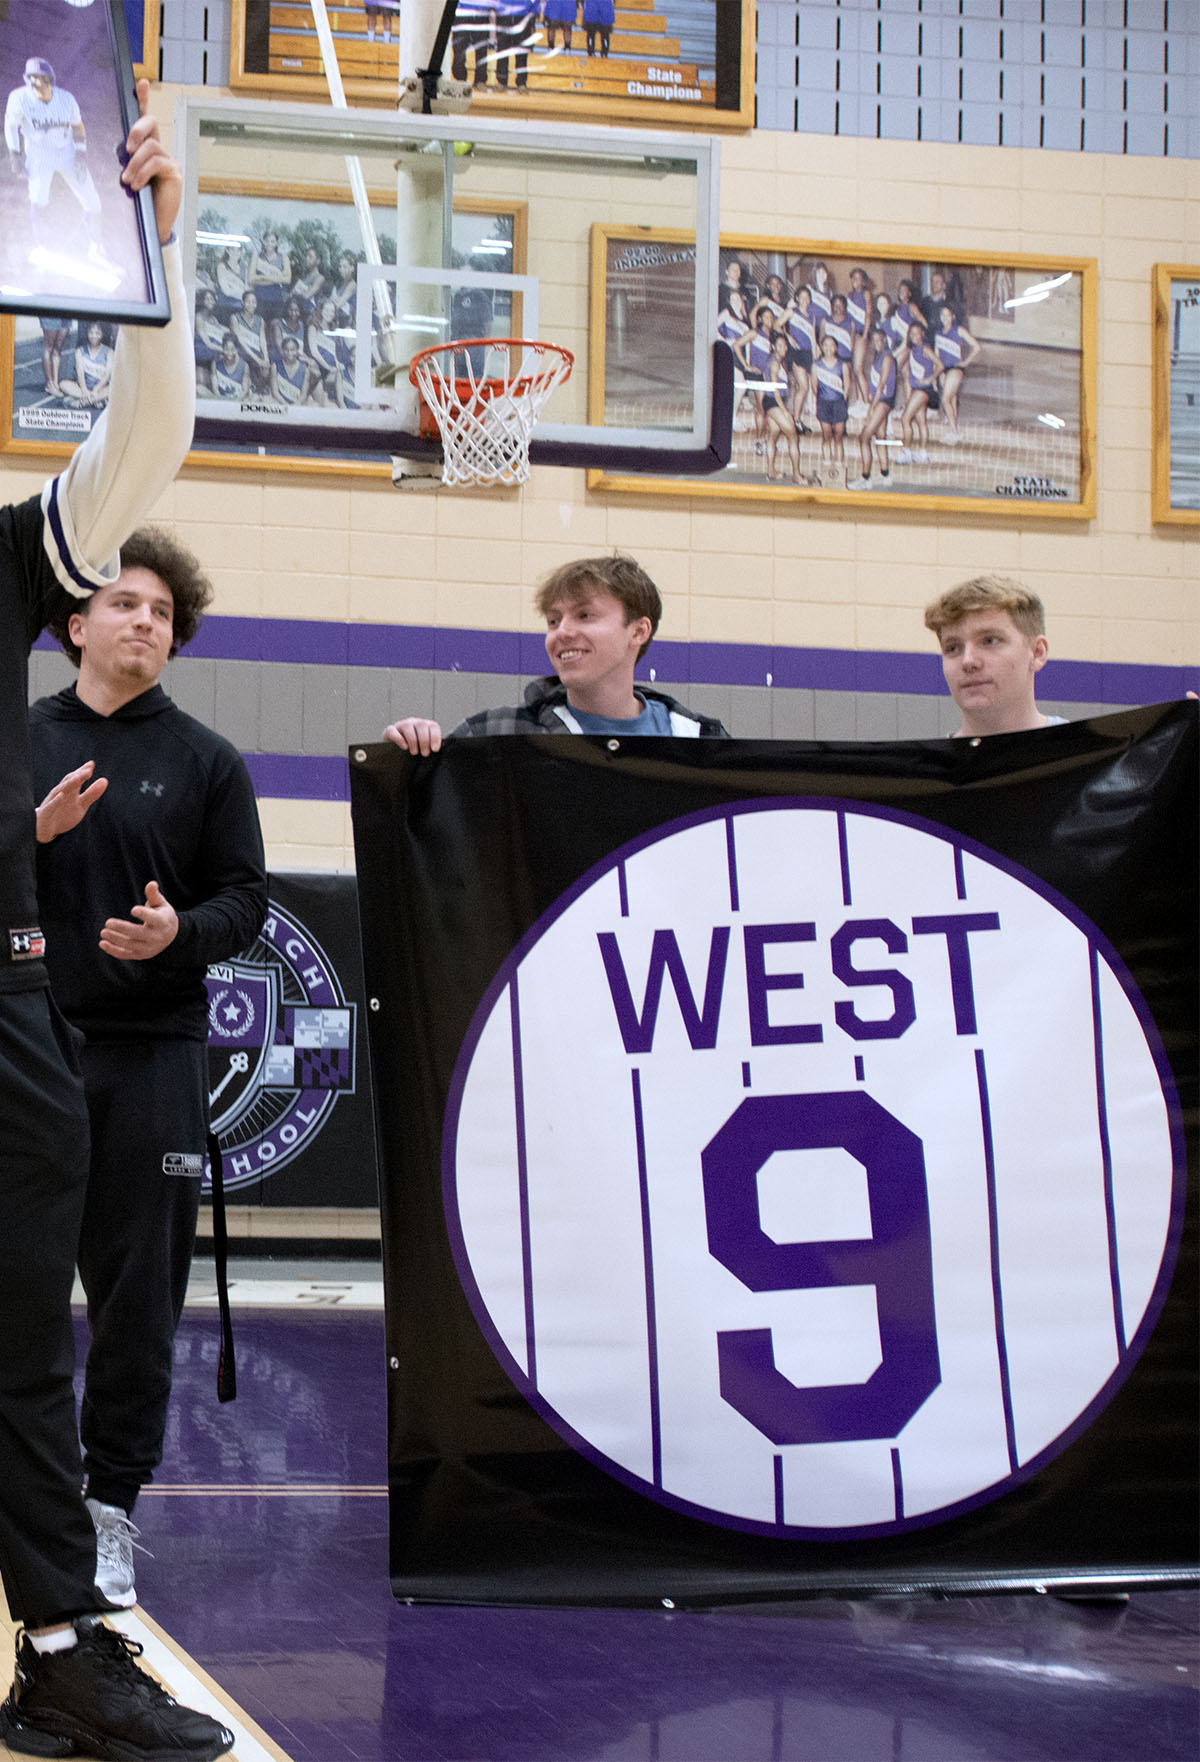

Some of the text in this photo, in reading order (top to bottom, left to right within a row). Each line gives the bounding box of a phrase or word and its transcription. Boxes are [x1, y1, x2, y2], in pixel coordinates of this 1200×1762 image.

[647, 67, 682, 83] State
[627, 81, 702, 100] Champions
[41, 410, 69, 418] Outdoor
[25, 418, 85, 428] State Champions
[1014, 476, 1052, 486] STATE
[996, 485, 1068, 497] CHAMPIONS
[596, 911, 1000, 1054] WEST
[701, 1090, 942, 1446] 9
